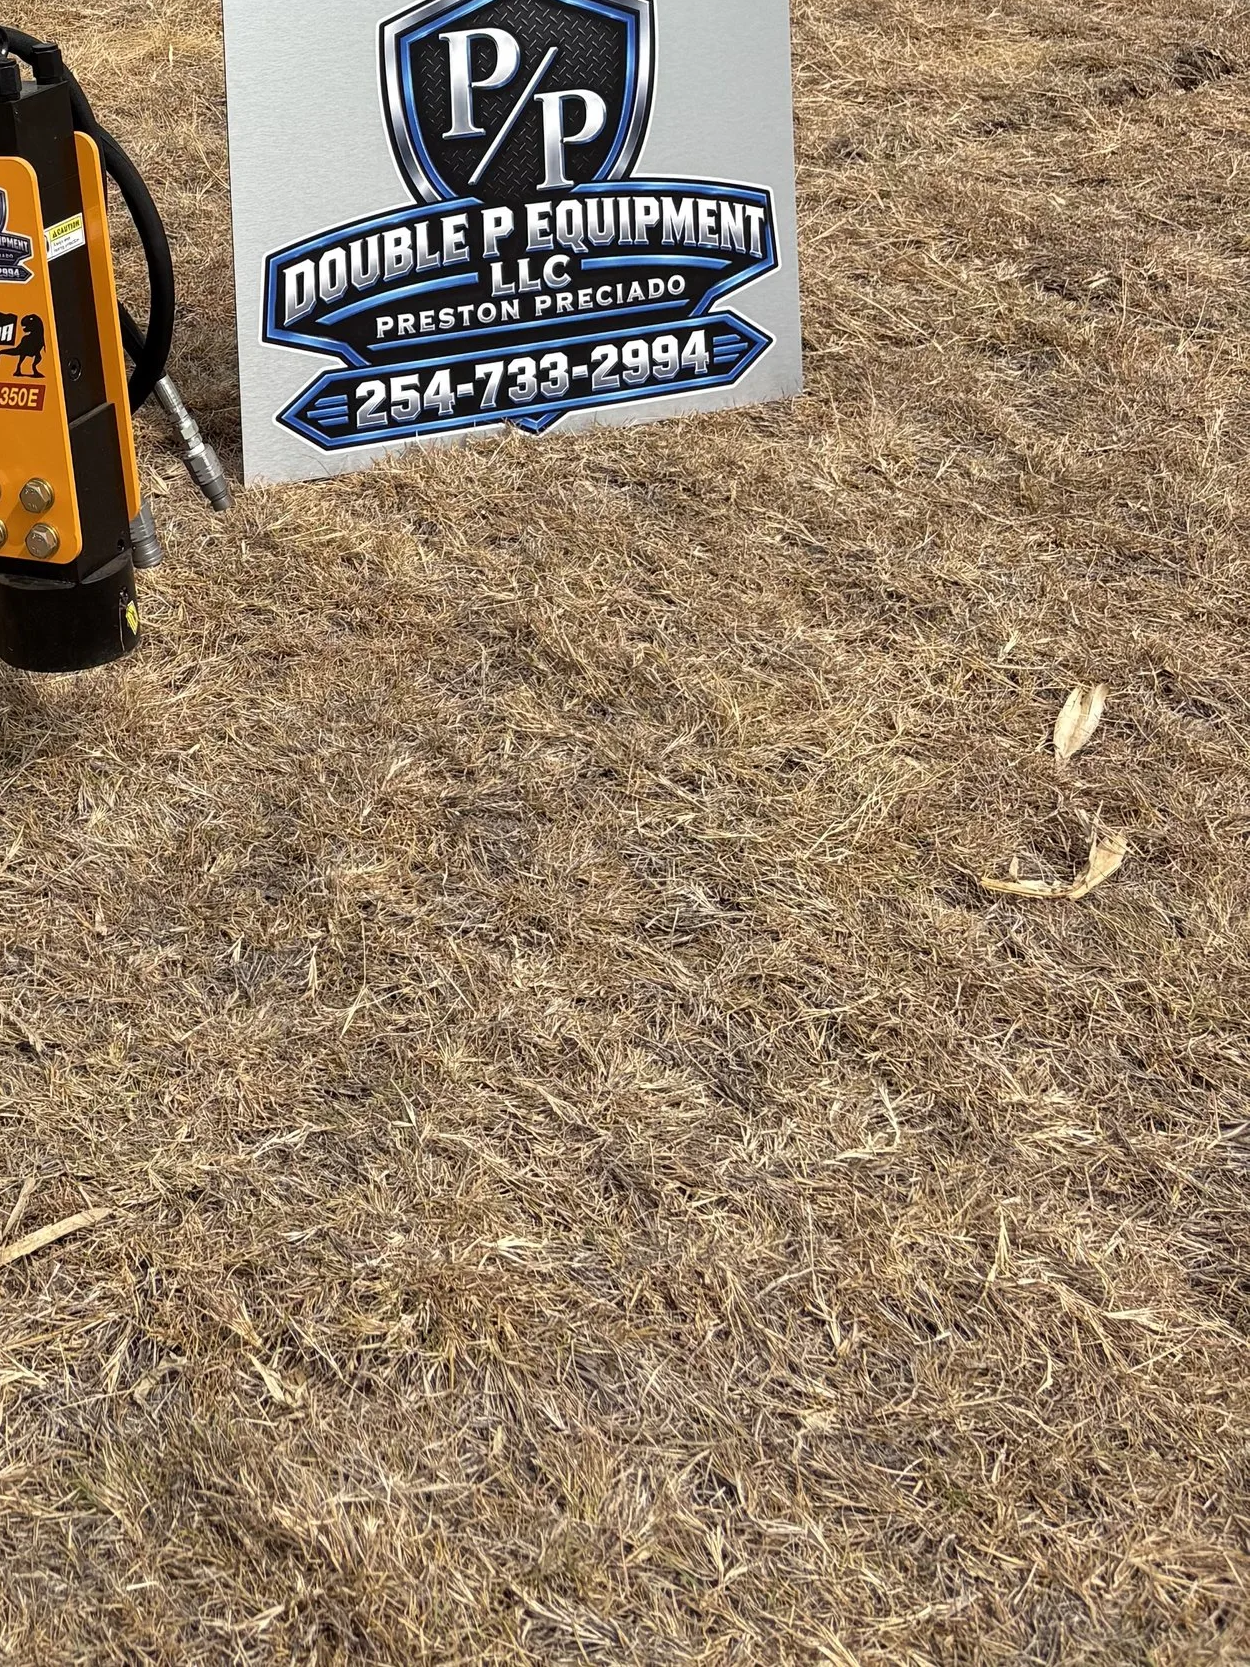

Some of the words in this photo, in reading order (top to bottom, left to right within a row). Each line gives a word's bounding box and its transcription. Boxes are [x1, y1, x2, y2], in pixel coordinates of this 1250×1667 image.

[56, 219, 80, 236] CAUTION
[281, 210, 472, 328] DOUBLE
[483, 205, 514, 259] P
[526, 196, 765, 258] EQUIPMENT
[491, 254, 572, 298] LLC
[375, 299, 521, 338] PRESTON
[534, 274, 686, 317] PRECIADO
[0, 387, 39, 407] 350E
[354, 329, 710, 428] 254-733-2994
